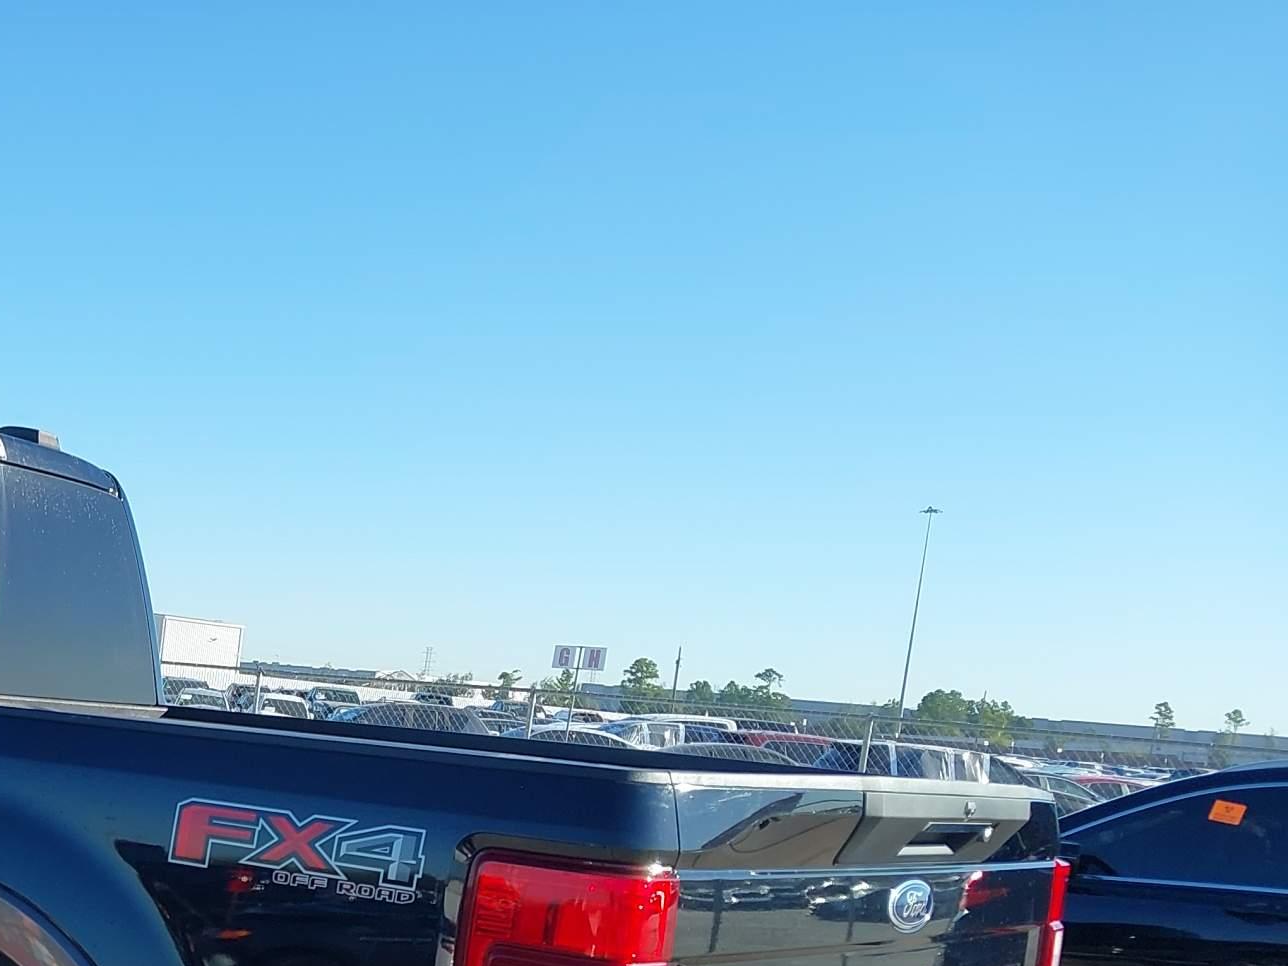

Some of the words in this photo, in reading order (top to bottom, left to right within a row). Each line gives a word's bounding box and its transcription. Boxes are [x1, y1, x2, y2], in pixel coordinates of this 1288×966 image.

[558, 647, 570, 667] G
[588, 649, 601, 668] H
[168, 798, 427, 891] FX4
[272, 870, 328, 890] OFF
[336, 881, 416, 904] ROAD
[903, 890, 928, 918] Ford
